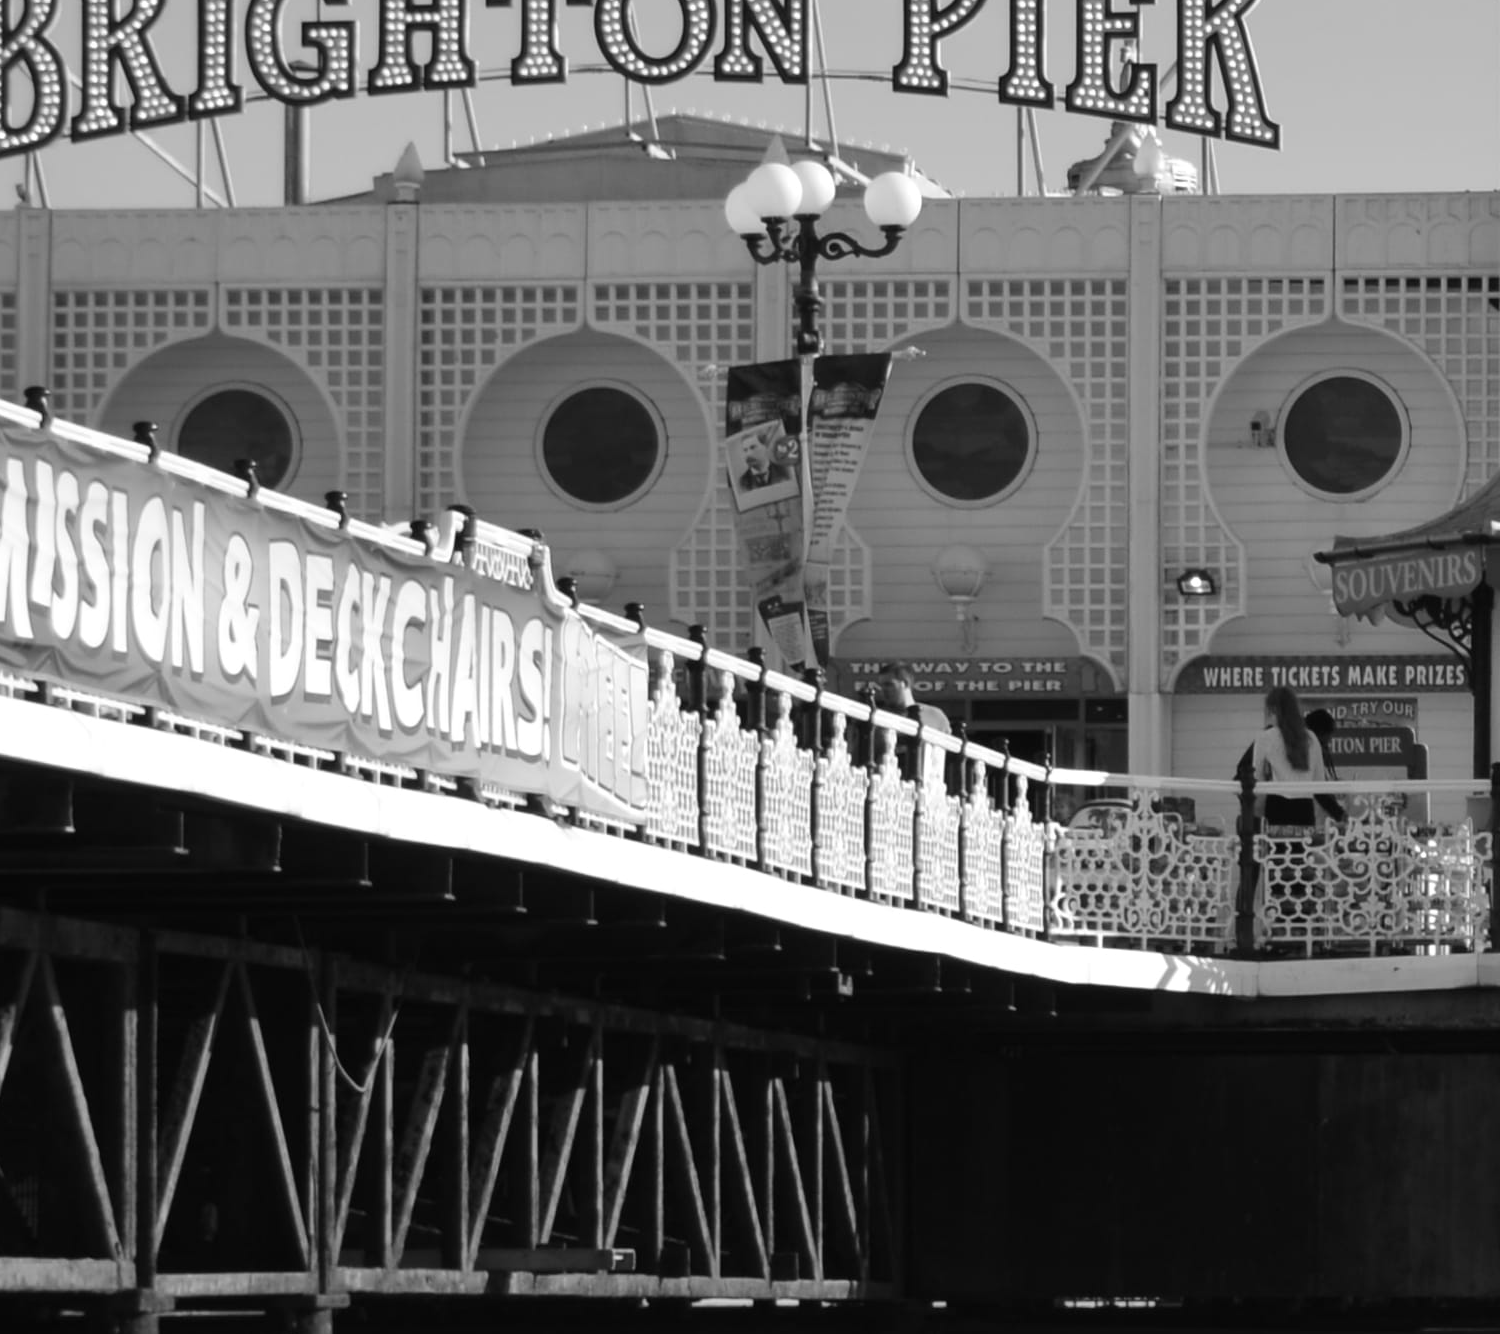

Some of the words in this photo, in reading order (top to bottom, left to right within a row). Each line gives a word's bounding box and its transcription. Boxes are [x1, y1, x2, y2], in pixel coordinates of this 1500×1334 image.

[1335, 550, 1477, 605] SOUVENIRS
[218, 533, 261, 680] &
[911, 662, 970, 674] WAY
[978, 662, 1013, 673] TO
[1021, 662, 1067, 673] THE
[1203, 667, 1264, 687] WHERE
[1271, 666, 1341, 687] TICKETS
[1347, 666, 1398, 686] MAKE
[1405, 665, 1466, 686] PRIZES
[913, 681, 946, 692] OF
[954, 681, 1000, 692] THE
[1008, 680, 1063, 692] PIER
[1351, 701, 1379, 718] TRY
[1382, 700, 1414, 718] OUR
[1369, 736, 1403, 754] PIER
